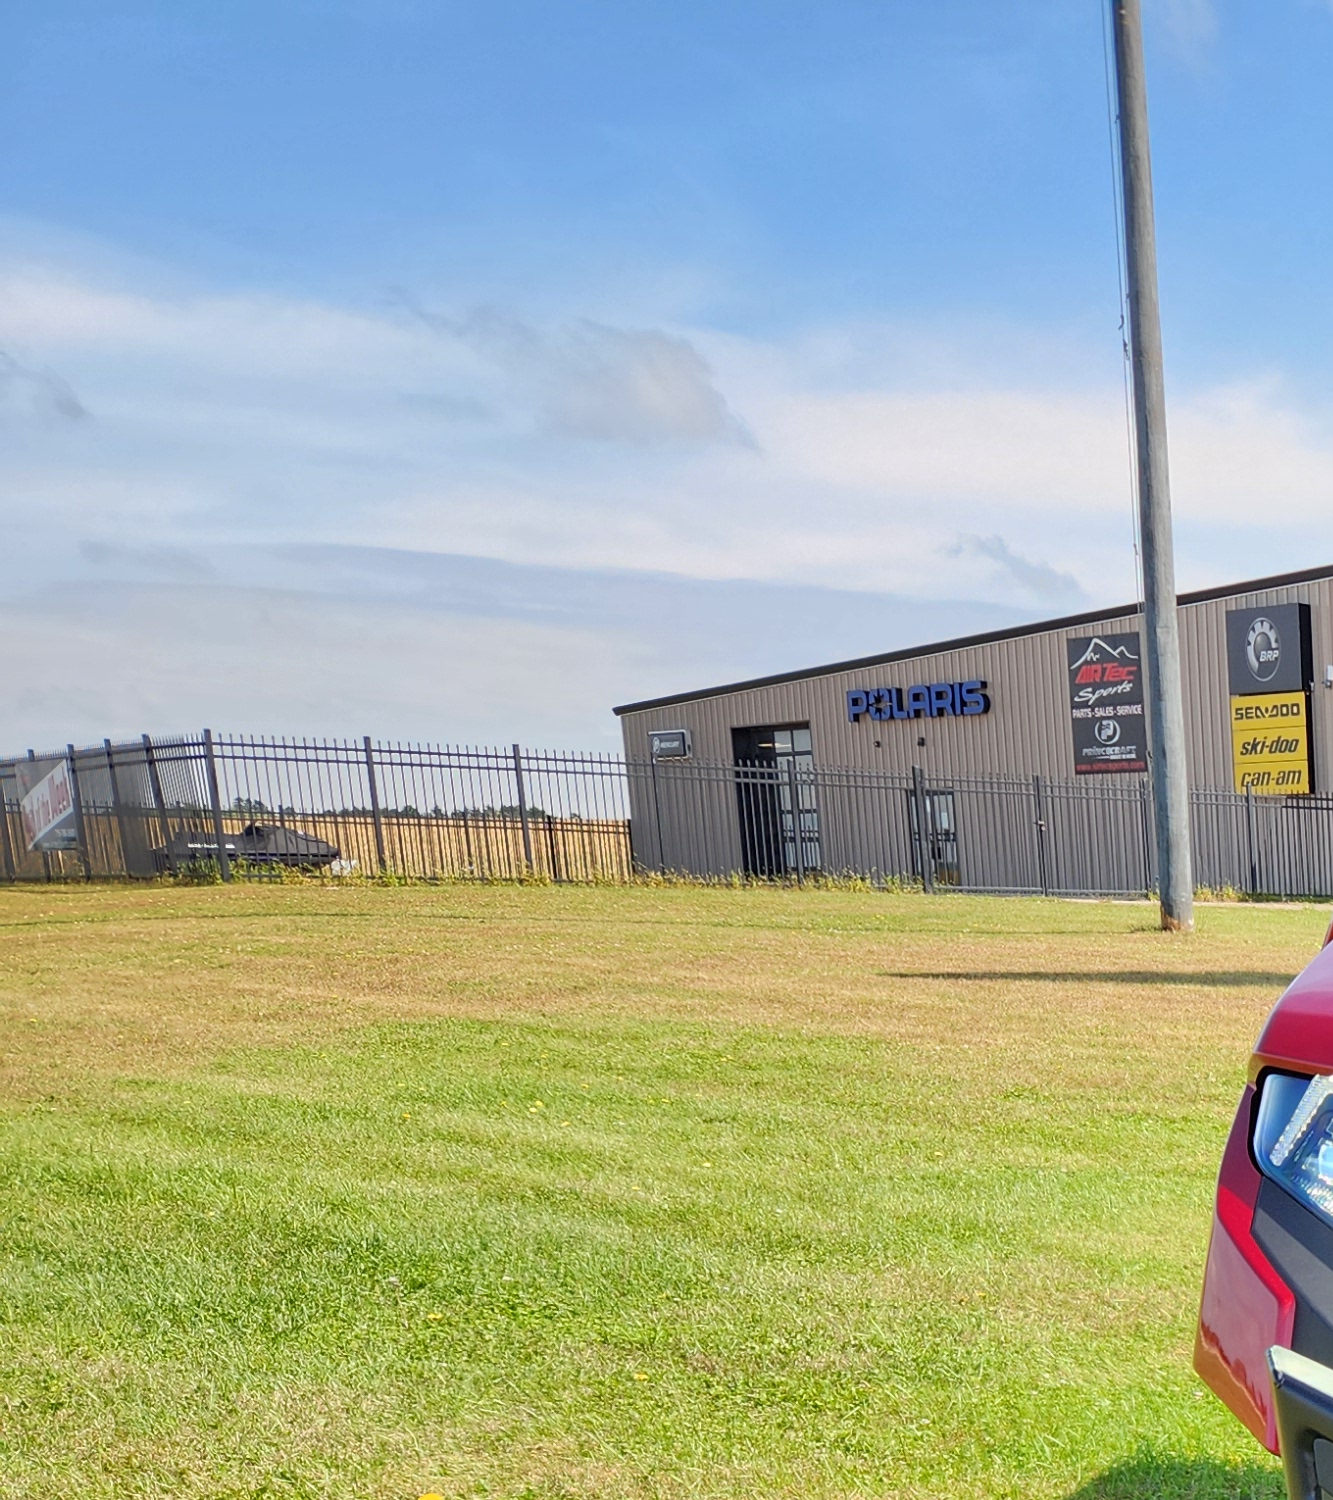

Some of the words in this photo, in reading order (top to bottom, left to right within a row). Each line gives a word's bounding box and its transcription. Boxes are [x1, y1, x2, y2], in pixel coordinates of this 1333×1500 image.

[1259, 650, 1280, 662] BRP
[846, 680, 990, 723] POLARIS
[1074, 680, 1134, 705] Sports
[1239, 735, 1300, 756] ski-doo
[1241, 769, 1302, 788] can-am
